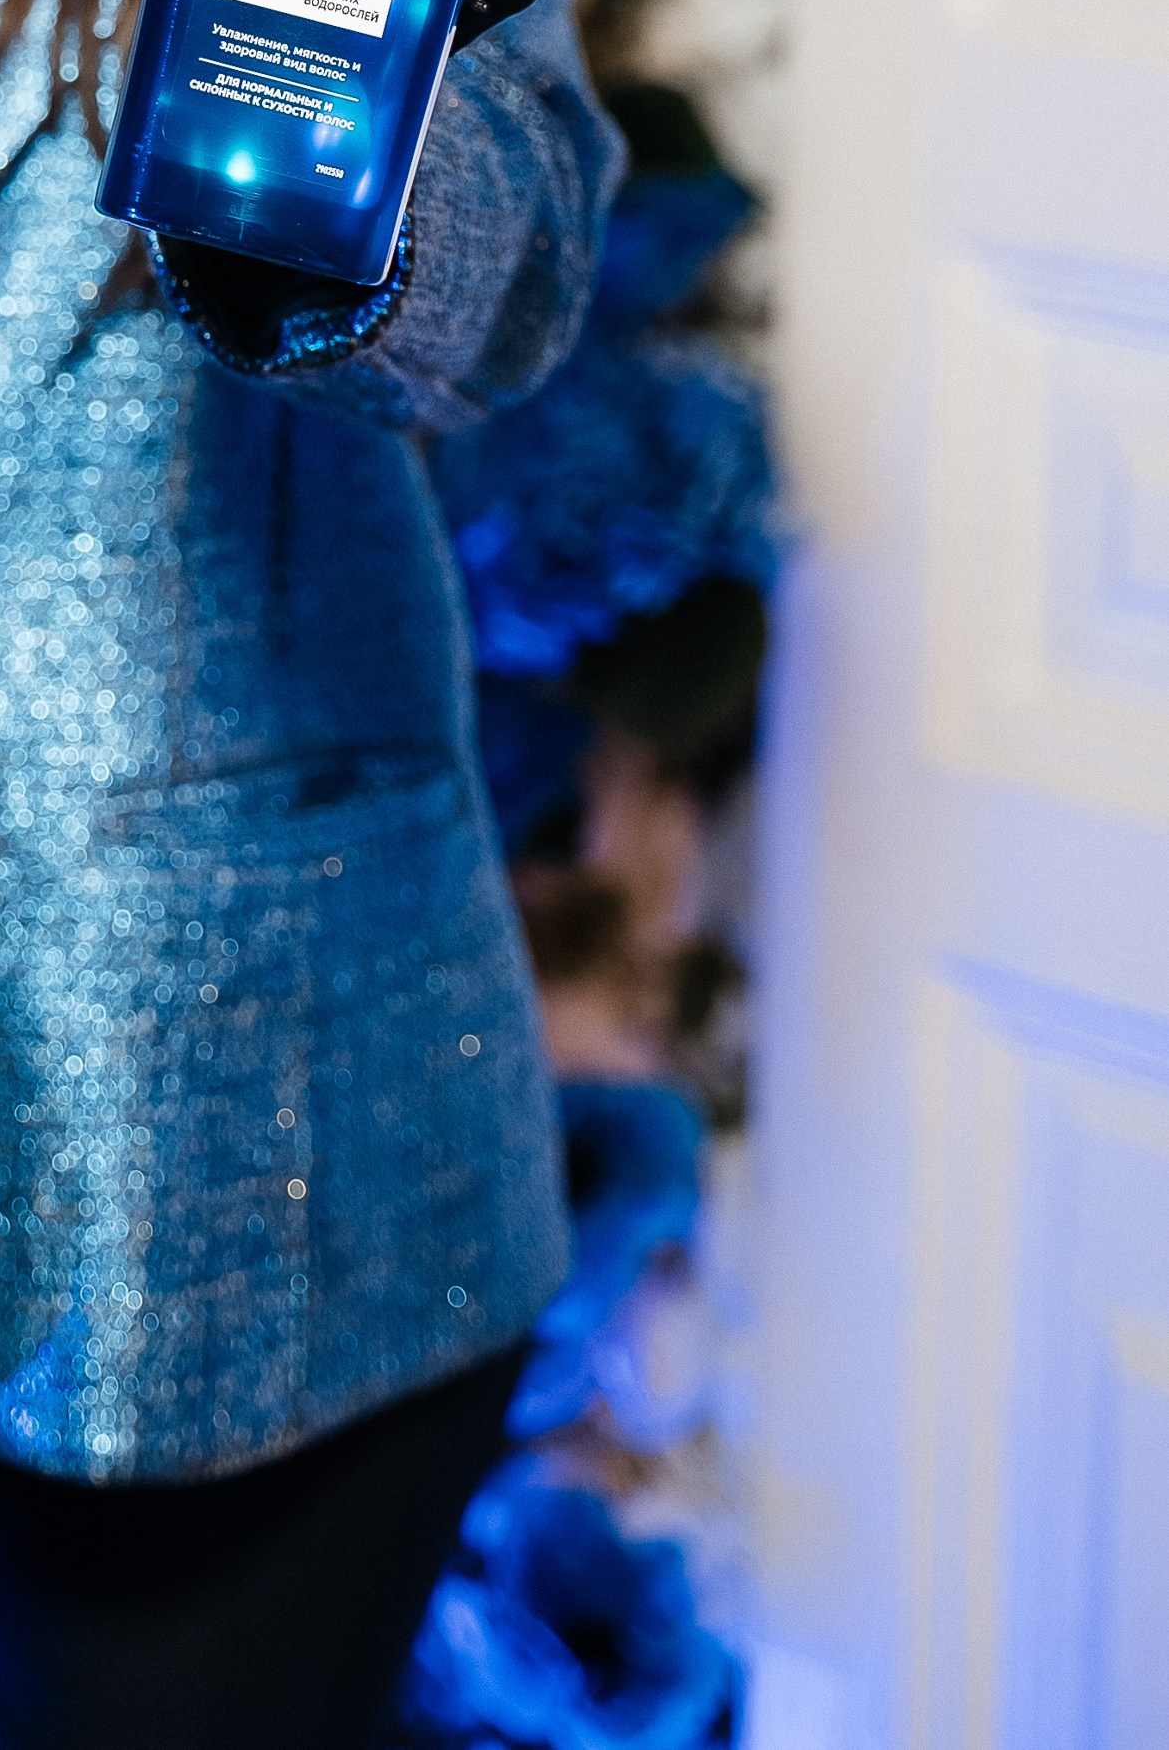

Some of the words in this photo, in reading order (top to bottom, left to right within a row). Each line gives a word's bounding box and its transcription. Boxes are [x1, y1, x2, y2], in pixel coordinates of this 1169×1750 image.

[212, 23, 291, 55] Увлажнение,
[293, 46, 350, 69] мягкость
[352, 62, 361, 72] и
[219, 41, 281, 65] здоровый
[283, 57, 307, 73] вид
[309, 66, 347, 82] волос
[189, 79, 251, 104] СКЛОННЫХ
[252, 95, 261, 107] К
[262, 99, 314, 120] СУХОСТИ
[316, 113, 356, 131] ВОЛОС
[215, 73, 240, 88] ДЛЯ
[241, 80, 323, 111] НОРМАЛЬНЫХ
[324, 102, 333, 112] И
